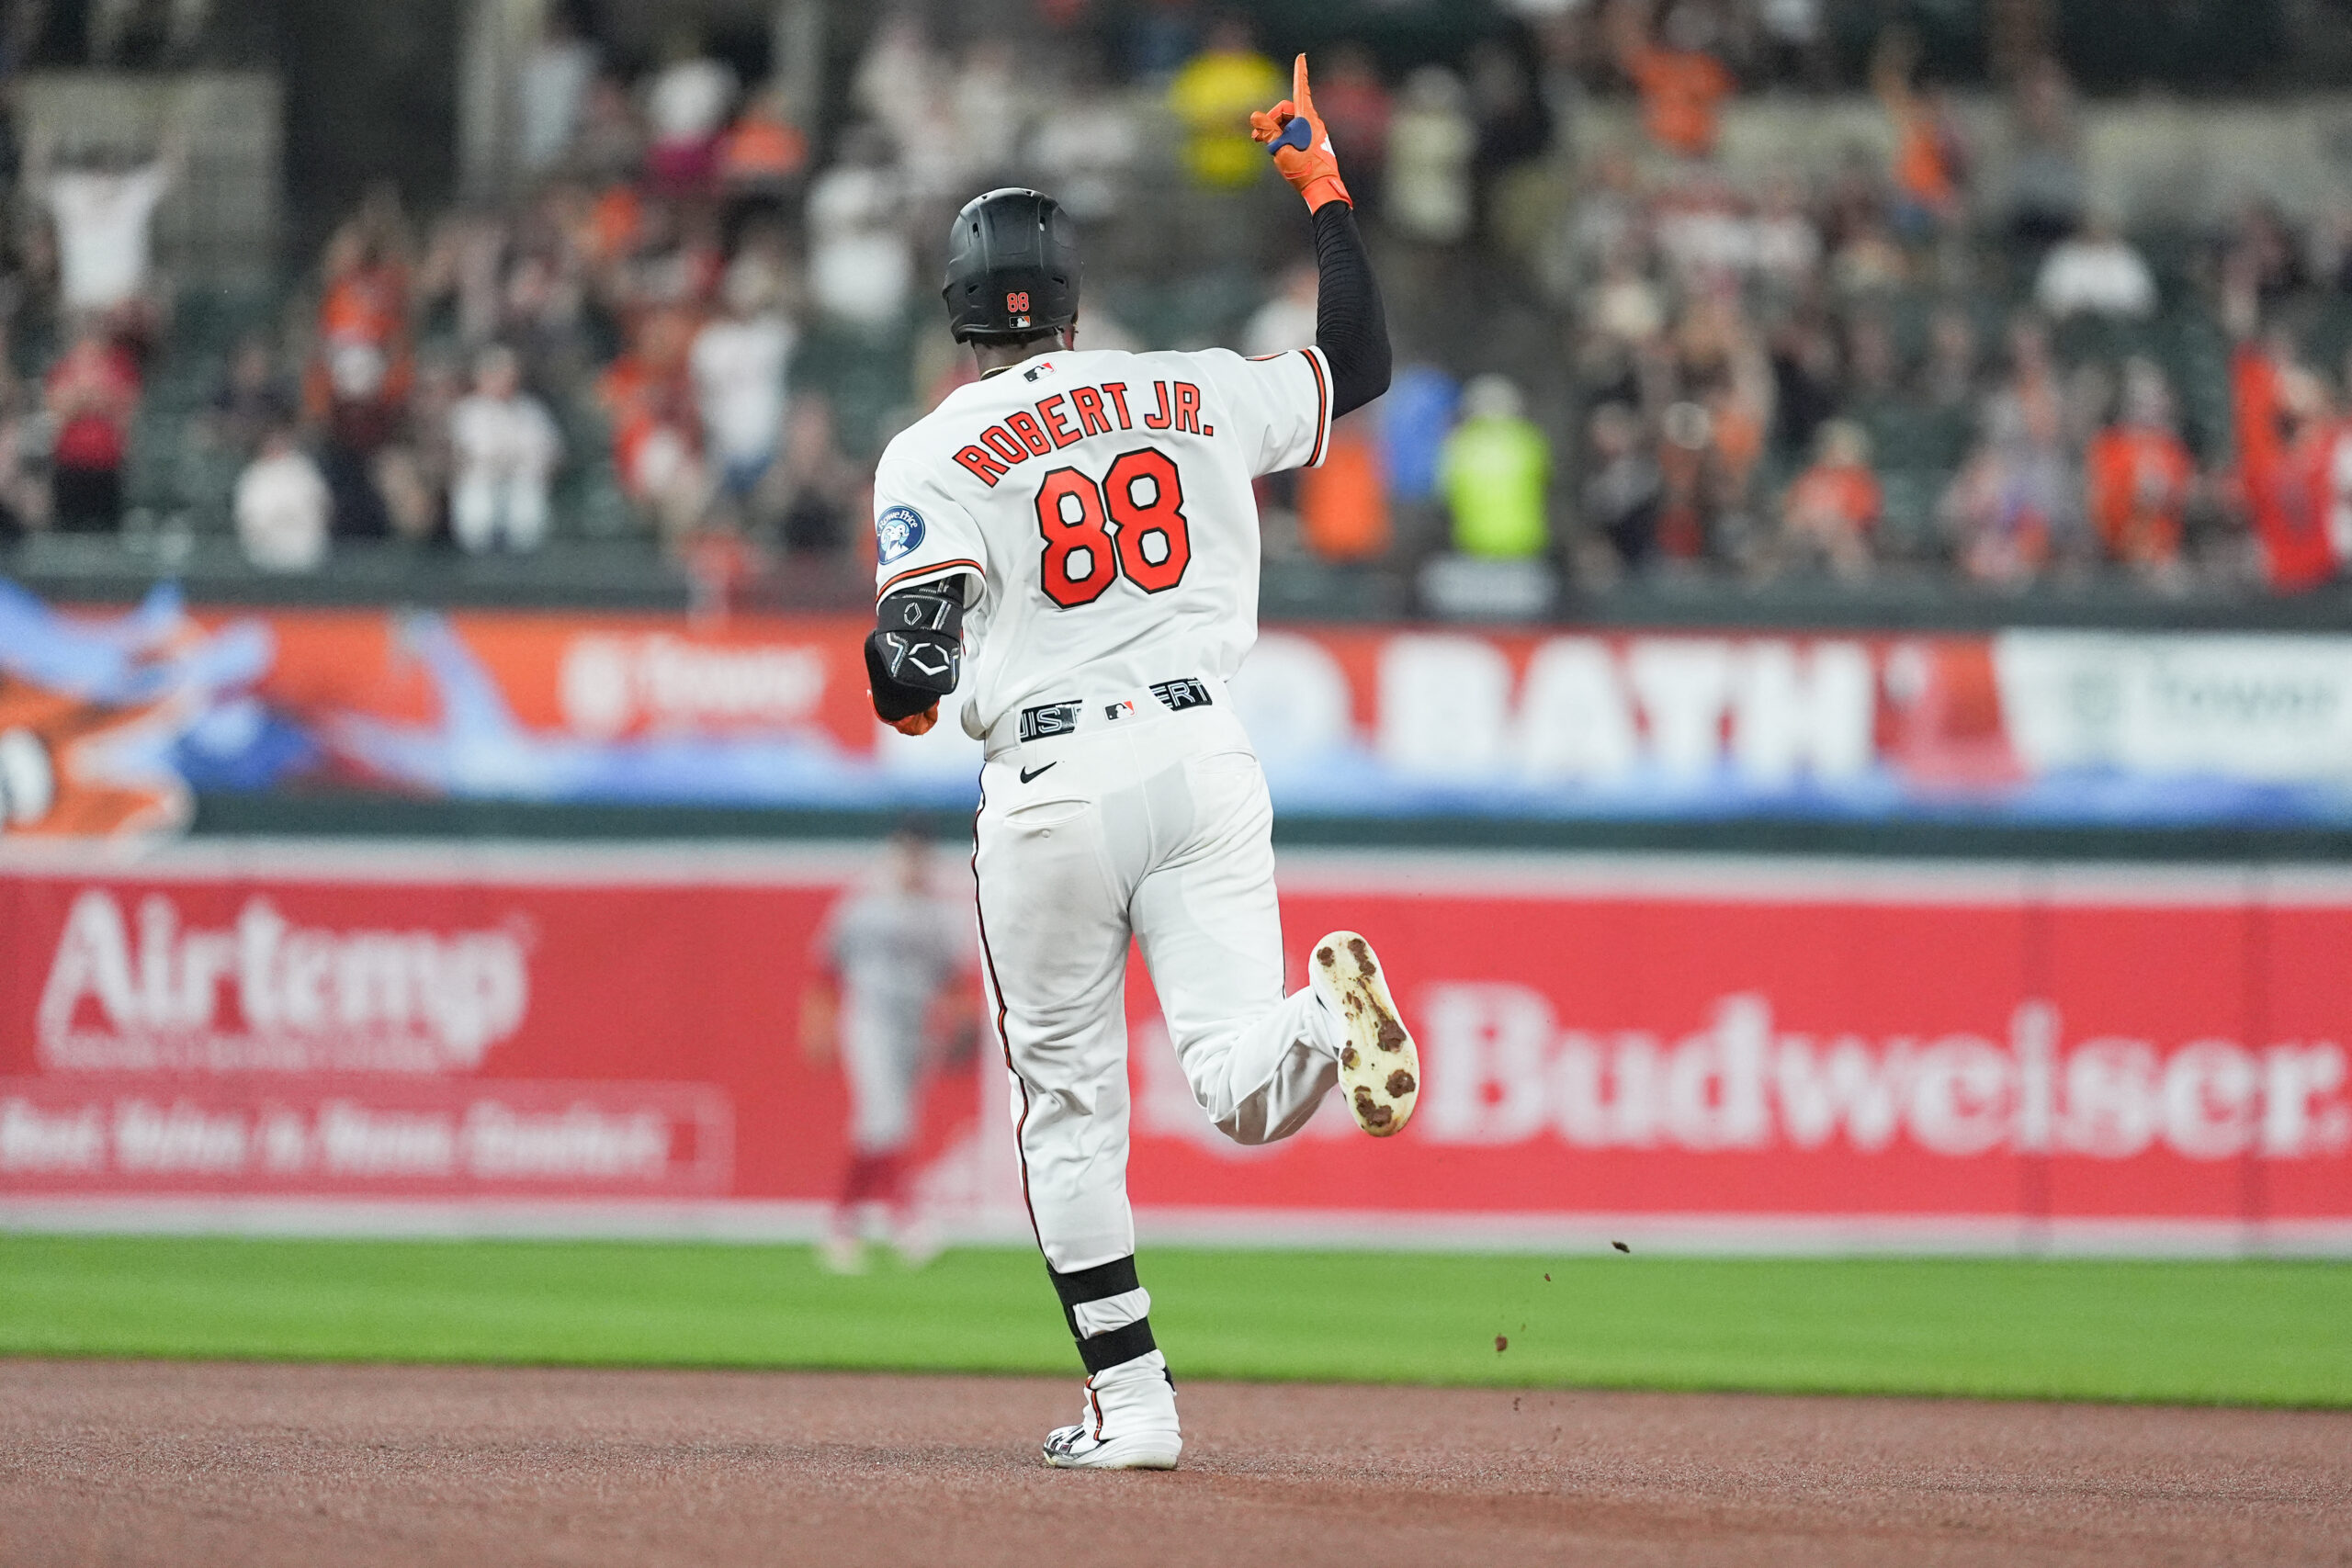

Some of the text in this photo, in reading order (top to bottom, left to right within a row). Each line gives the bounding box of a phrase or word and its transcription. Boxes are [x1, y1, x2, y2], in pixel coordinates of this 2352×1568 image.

[1007, 292, 1029, 312] 88
[952, 381, 1214, 488] ROBERT JR.
[900, 510, 918, 529] Price
[1035, 446, 1192, 609] 88
[1383, 636, 1876, 783] BATH
[37, 887, 530, 1069] Airtemp
